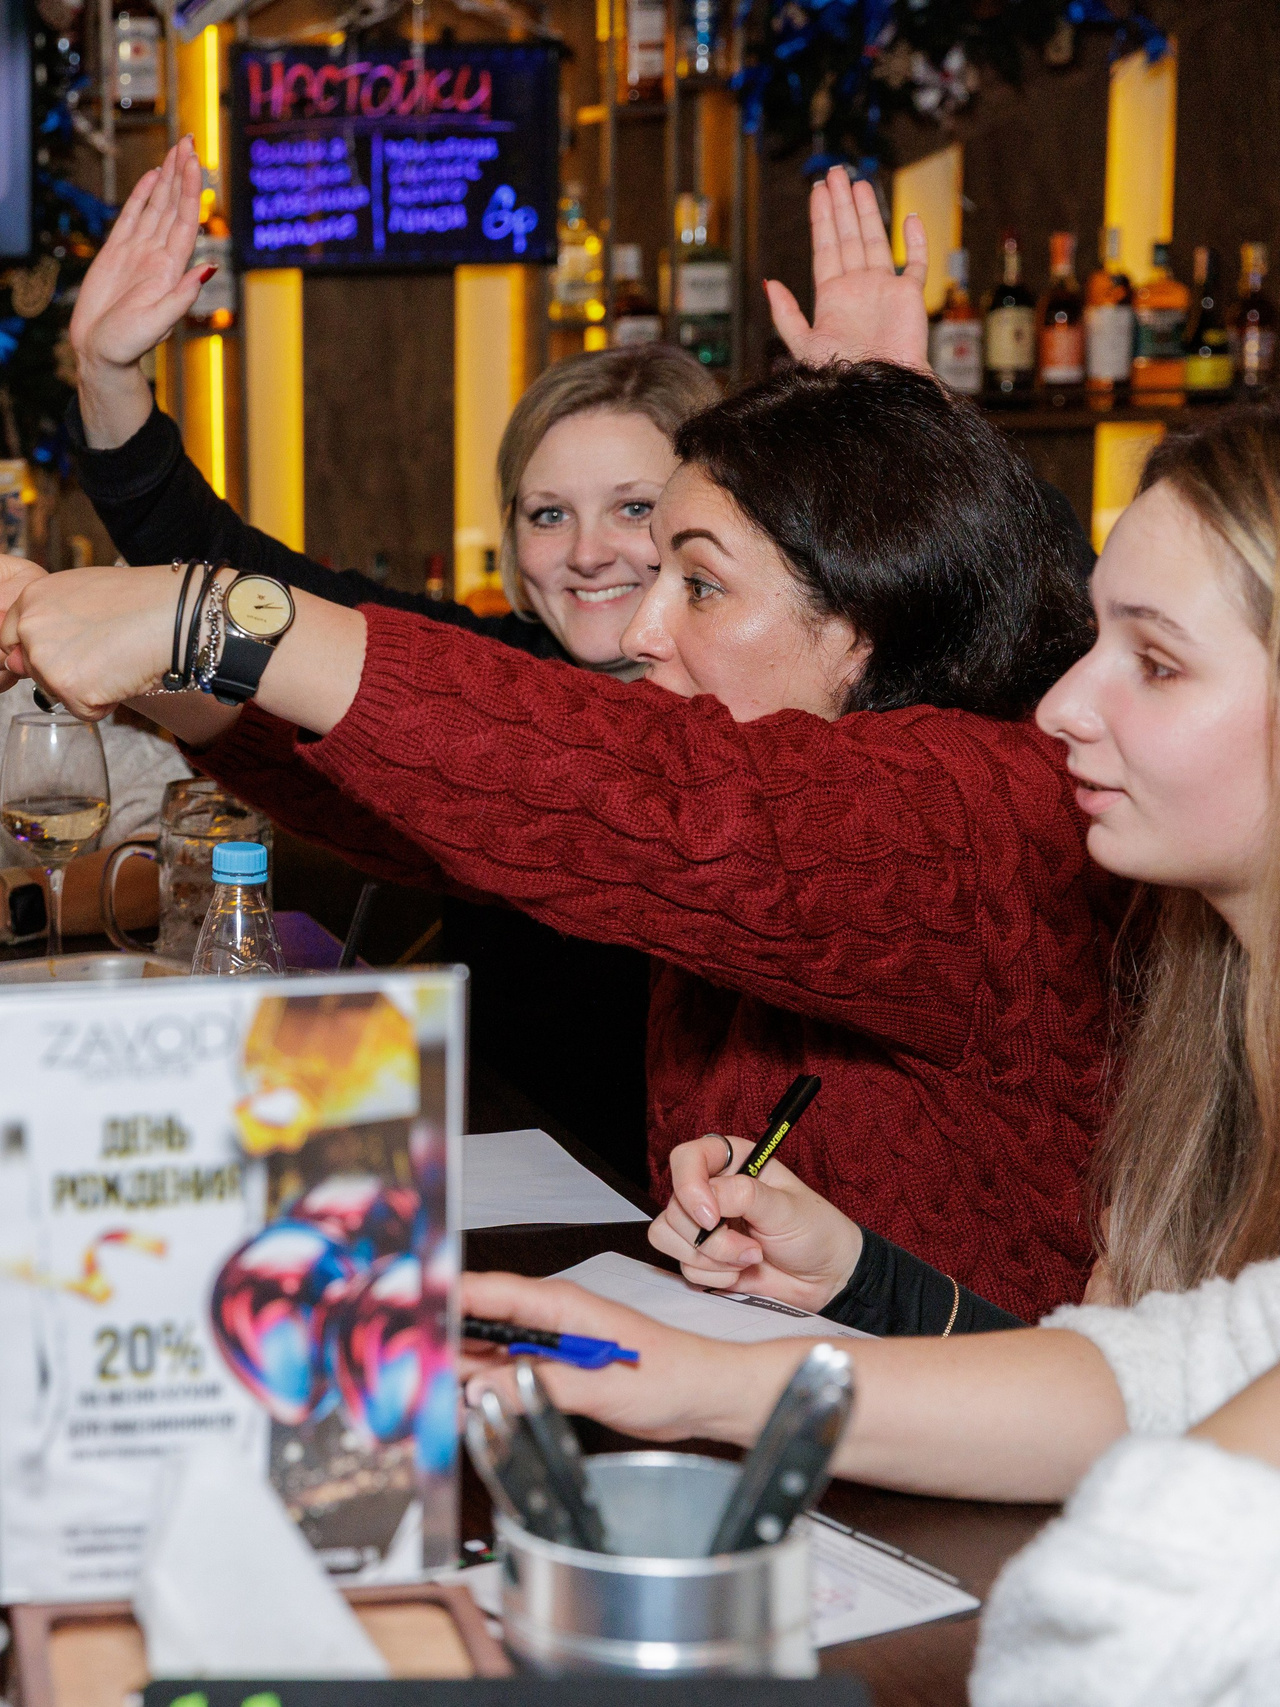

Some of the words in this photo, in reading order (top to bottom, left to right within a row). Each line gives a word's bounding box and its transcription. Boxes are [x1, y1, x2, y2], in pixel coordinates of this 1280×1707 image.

[41, 1015, 239, 1068] ZAVOD
[100, 1115, 192, 1157] ДЕНЬ
[754, 1121, 791, 1169] МАМАКВИЗ!
[52, 1163, 241, 1212] РОЖДЕНИЯ
[95, 1321, 205, 1381] 20%
